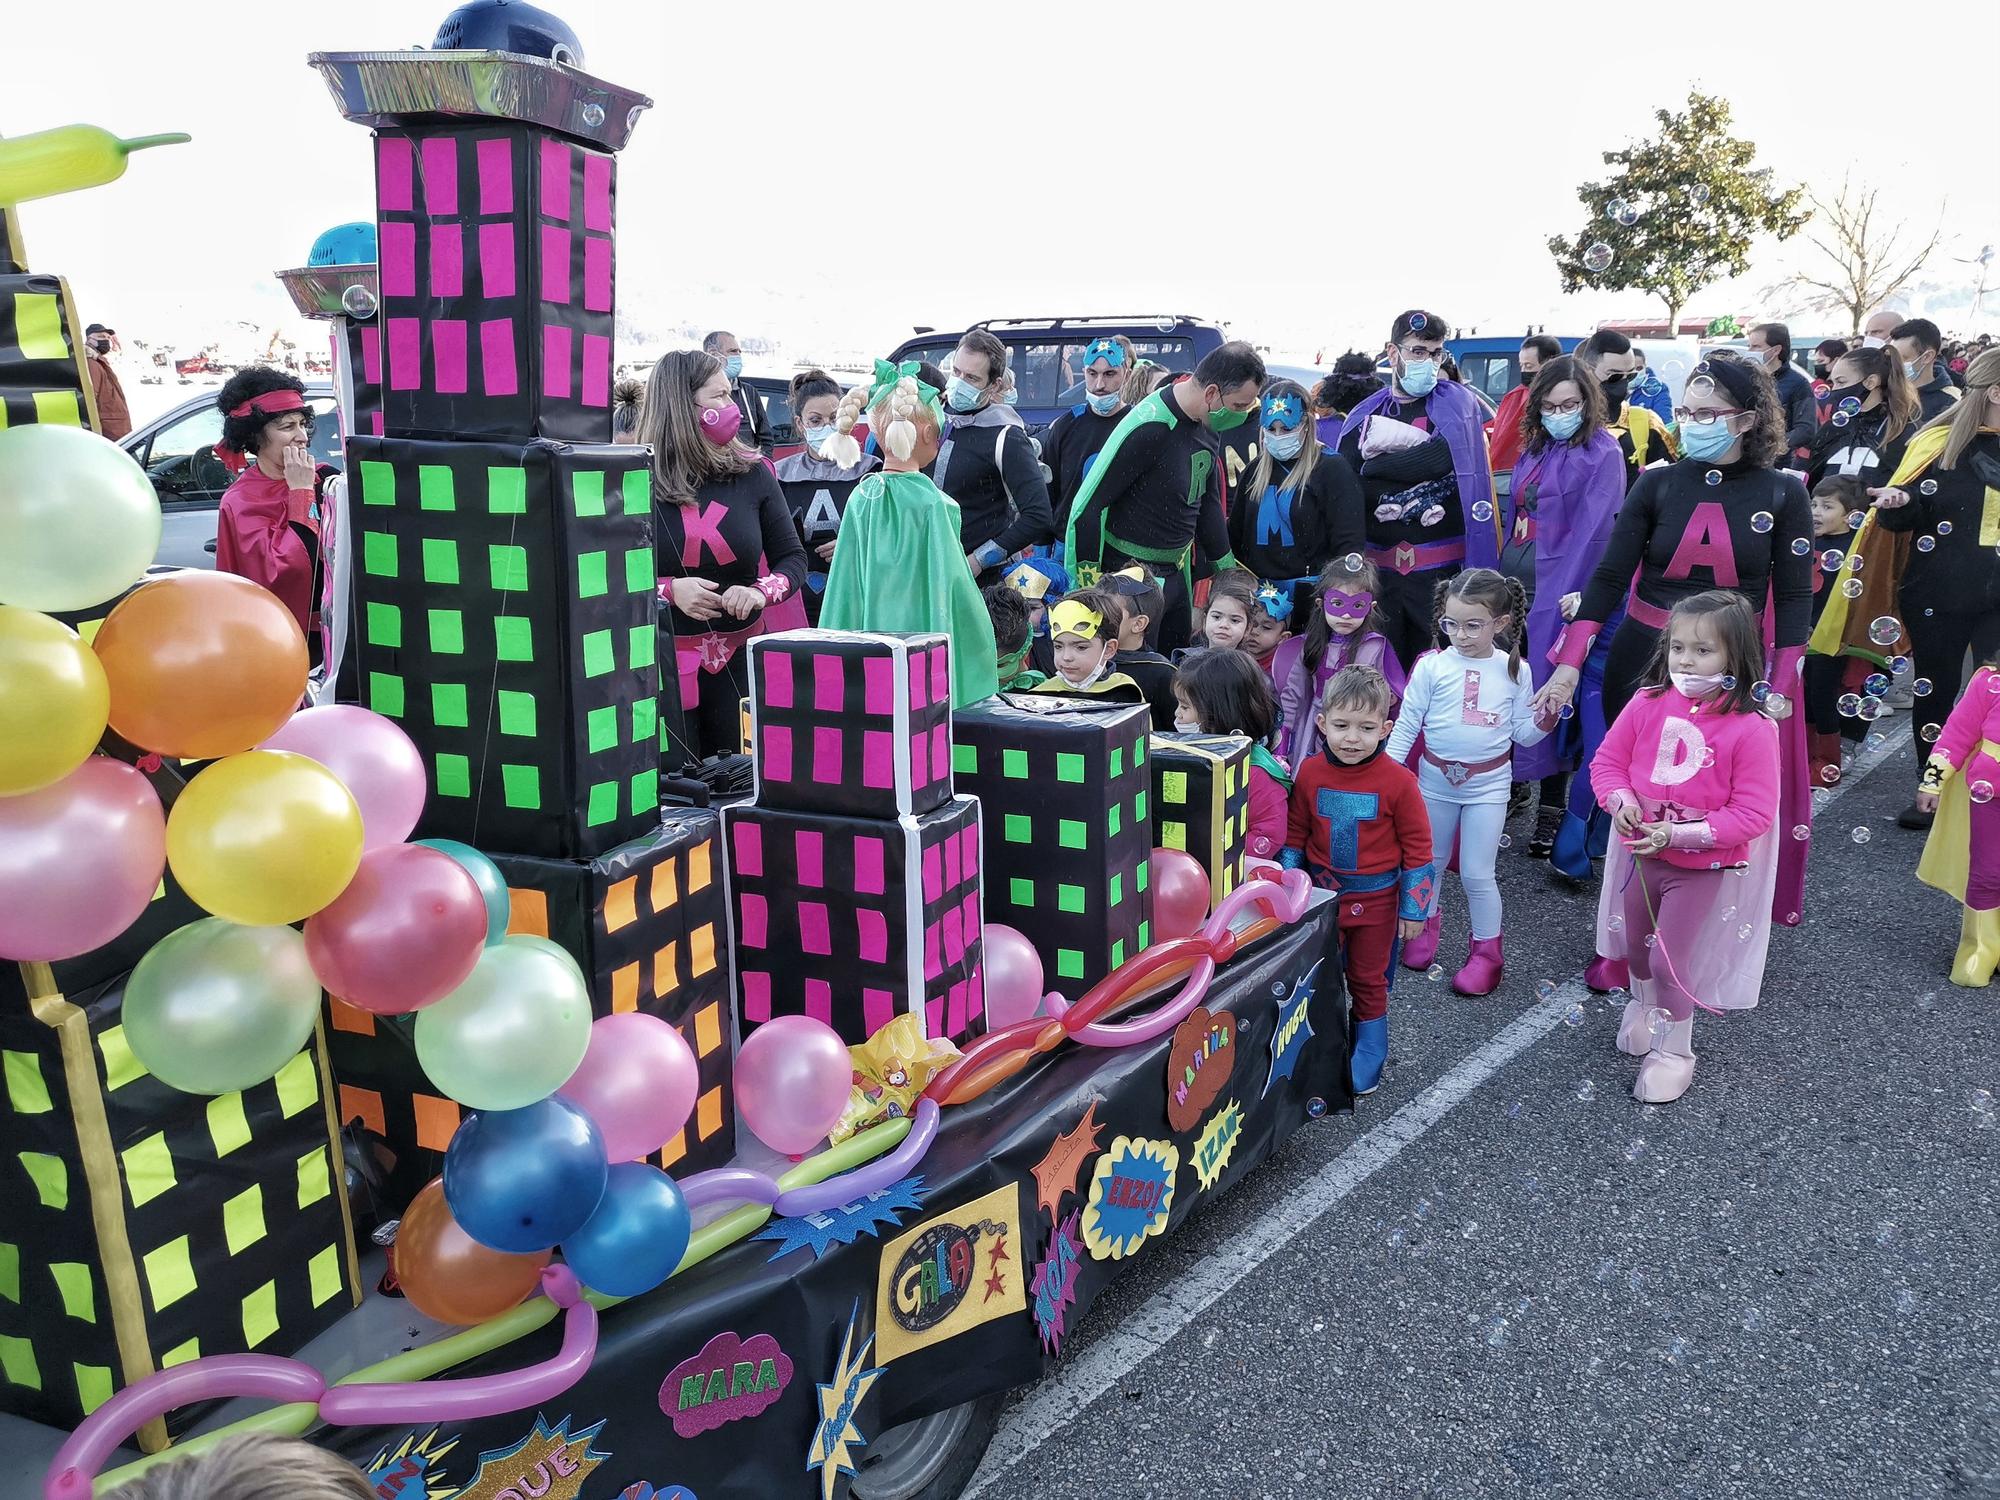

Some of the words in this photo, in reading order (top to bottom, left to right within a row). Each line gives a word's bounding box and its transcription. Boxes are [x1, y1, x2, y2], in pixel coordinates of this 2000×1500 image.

[680, 500, 737, 567] K
[804, 488, 842, 543] A
[1257, 485, 1294, 546] M
[1663, 502, 1739, 587] A
[1082, 571, 1094, 586] R
[1395, 547, 1415, 567] M
[1462, 670, 1501, 727] L
[1650, 716, 1706, 786] D
[1317, 787, 1379, 871] T
[1276, 996, 1308, 1059] HUGO
[1200, 1109, 1237, 1177] IZAN
[897, 1236, 971, 1316] GALA
[1035, 1231, 1076, 1342] NOA
[678, 1357, 780, 1412] NARA
